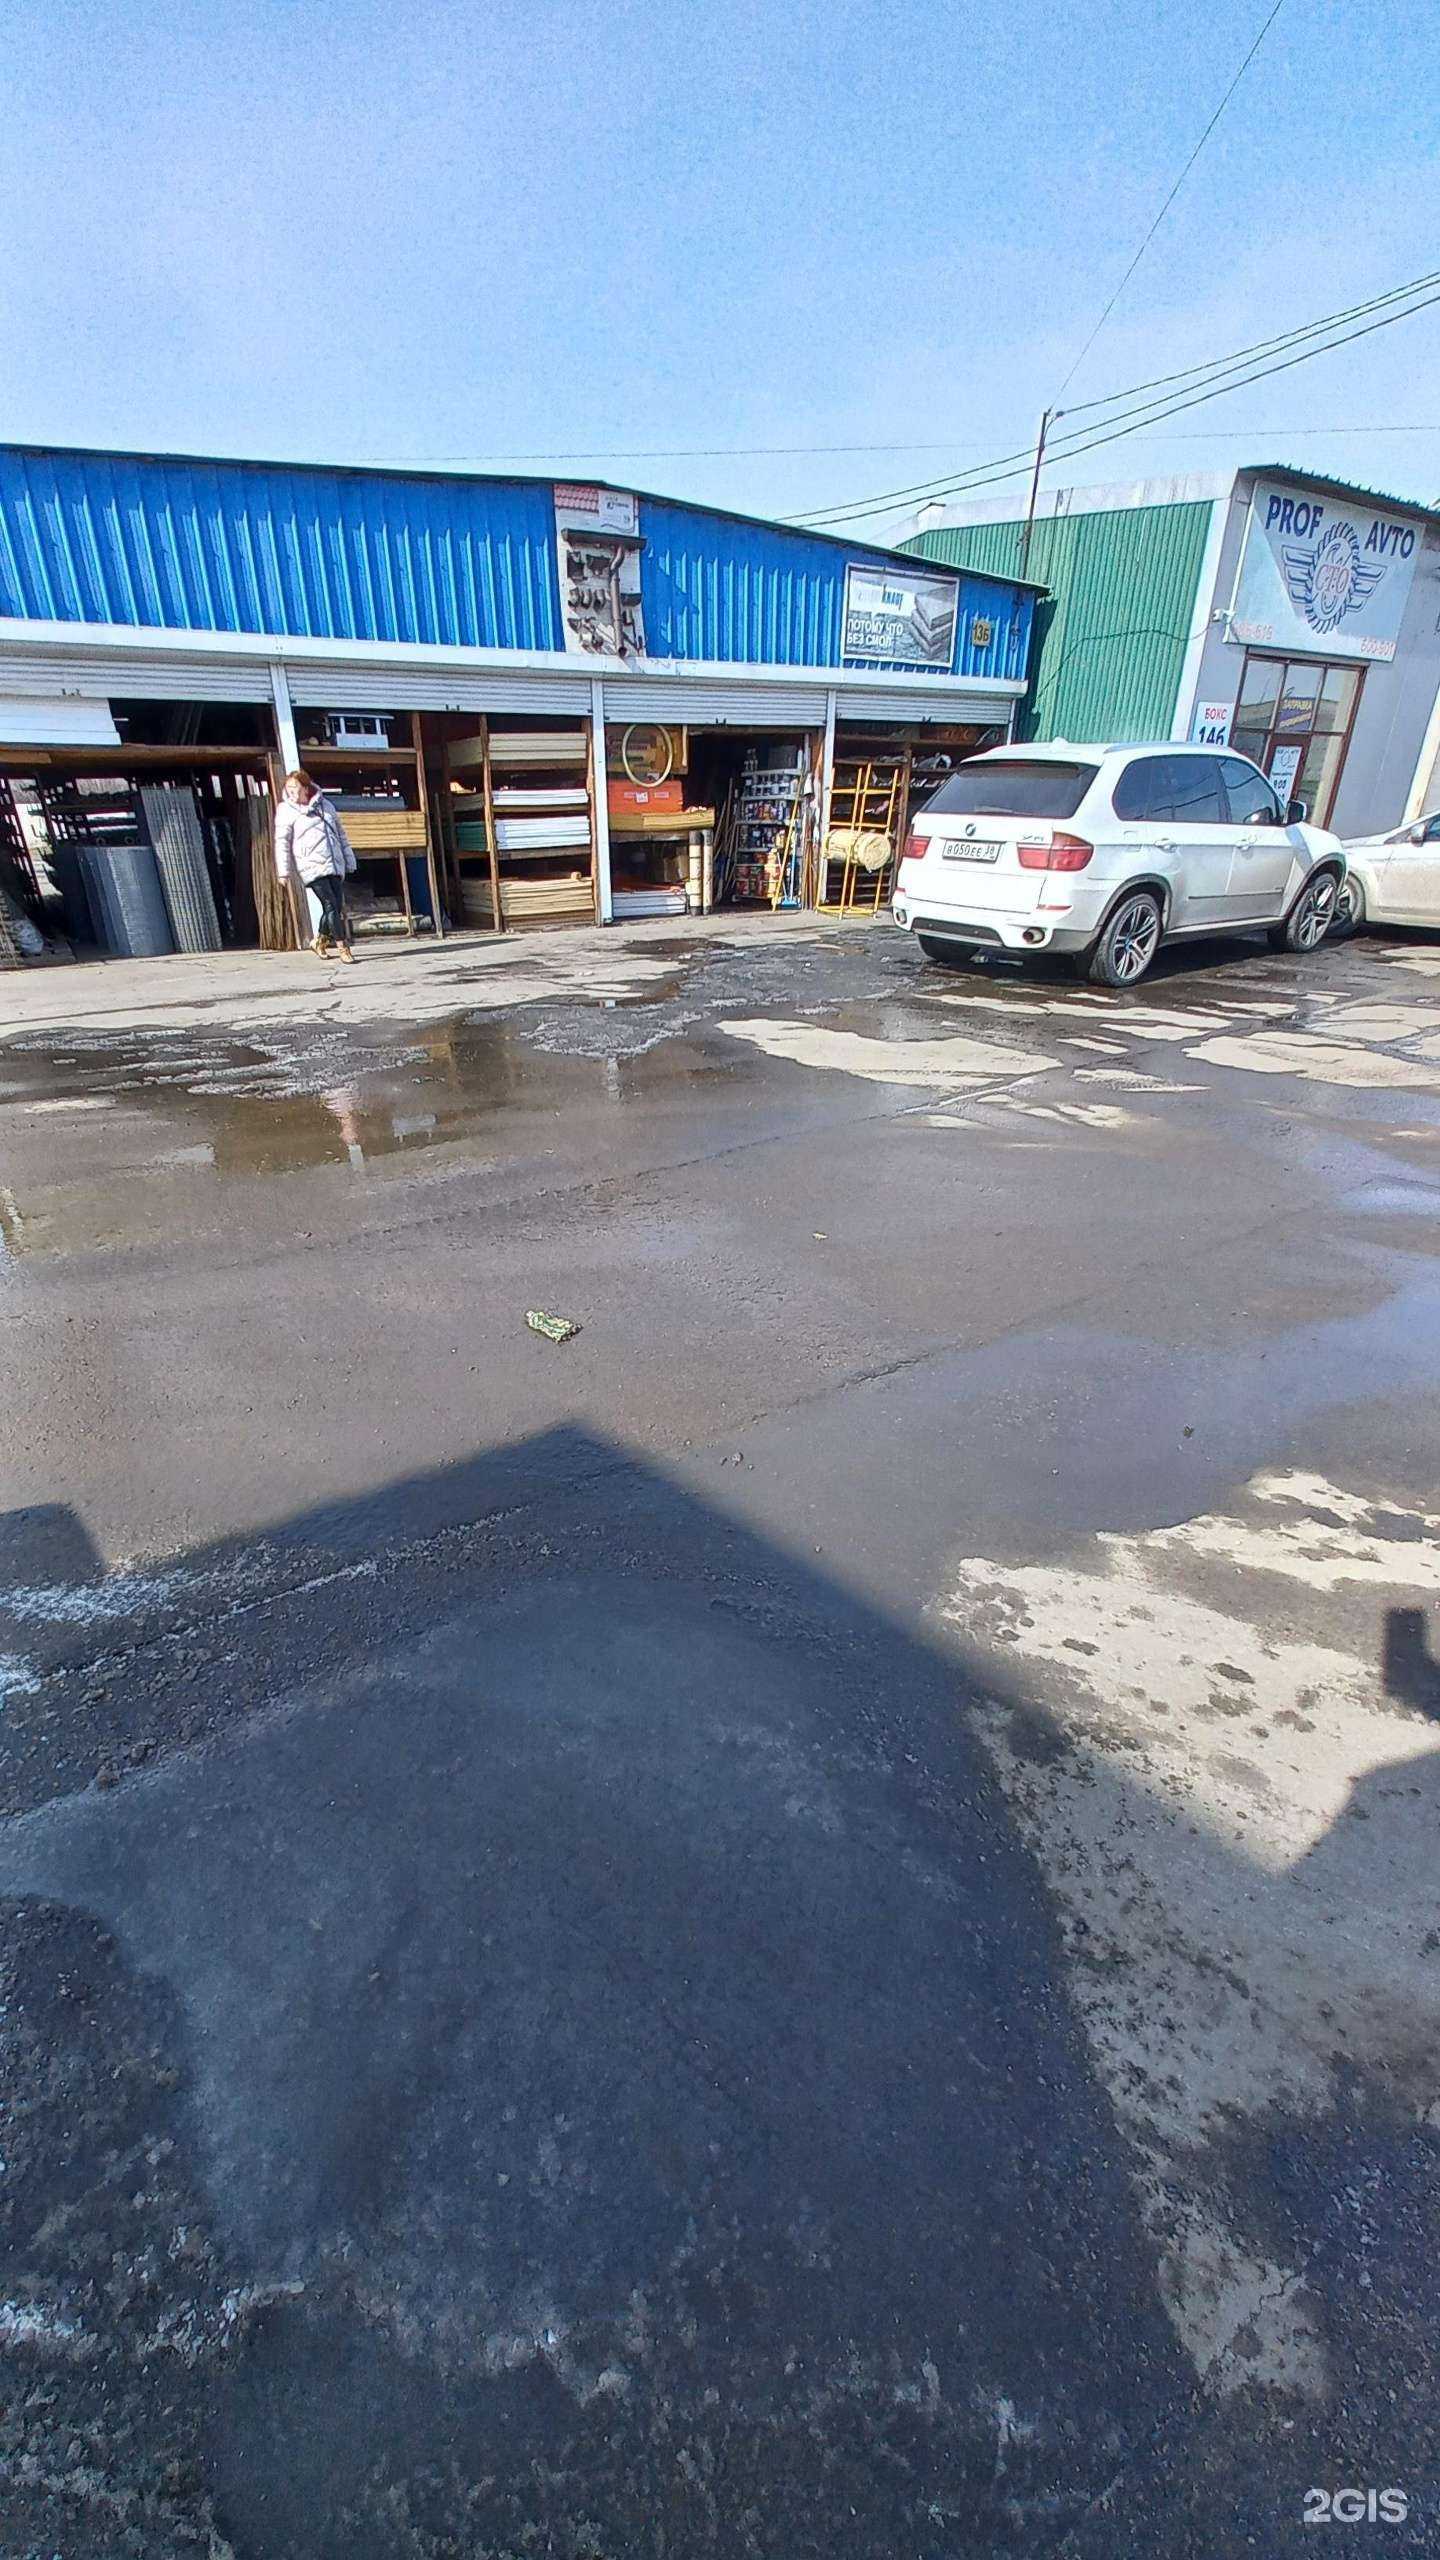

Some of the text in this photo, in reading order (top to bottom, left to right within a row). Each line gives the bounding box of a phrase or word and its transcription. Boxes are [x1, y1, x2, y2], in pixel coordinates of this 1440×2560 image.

[1265, 495, 1415, 559] PROF AVTO
[848, 619, 904, 635] ПОТОМУ ЧТО
[973, 623, 990, 643] 13Б
[847, 632, 892, 648] БЕЗ СМОЛ
[1204, 707, 1228, 720] БОКС
